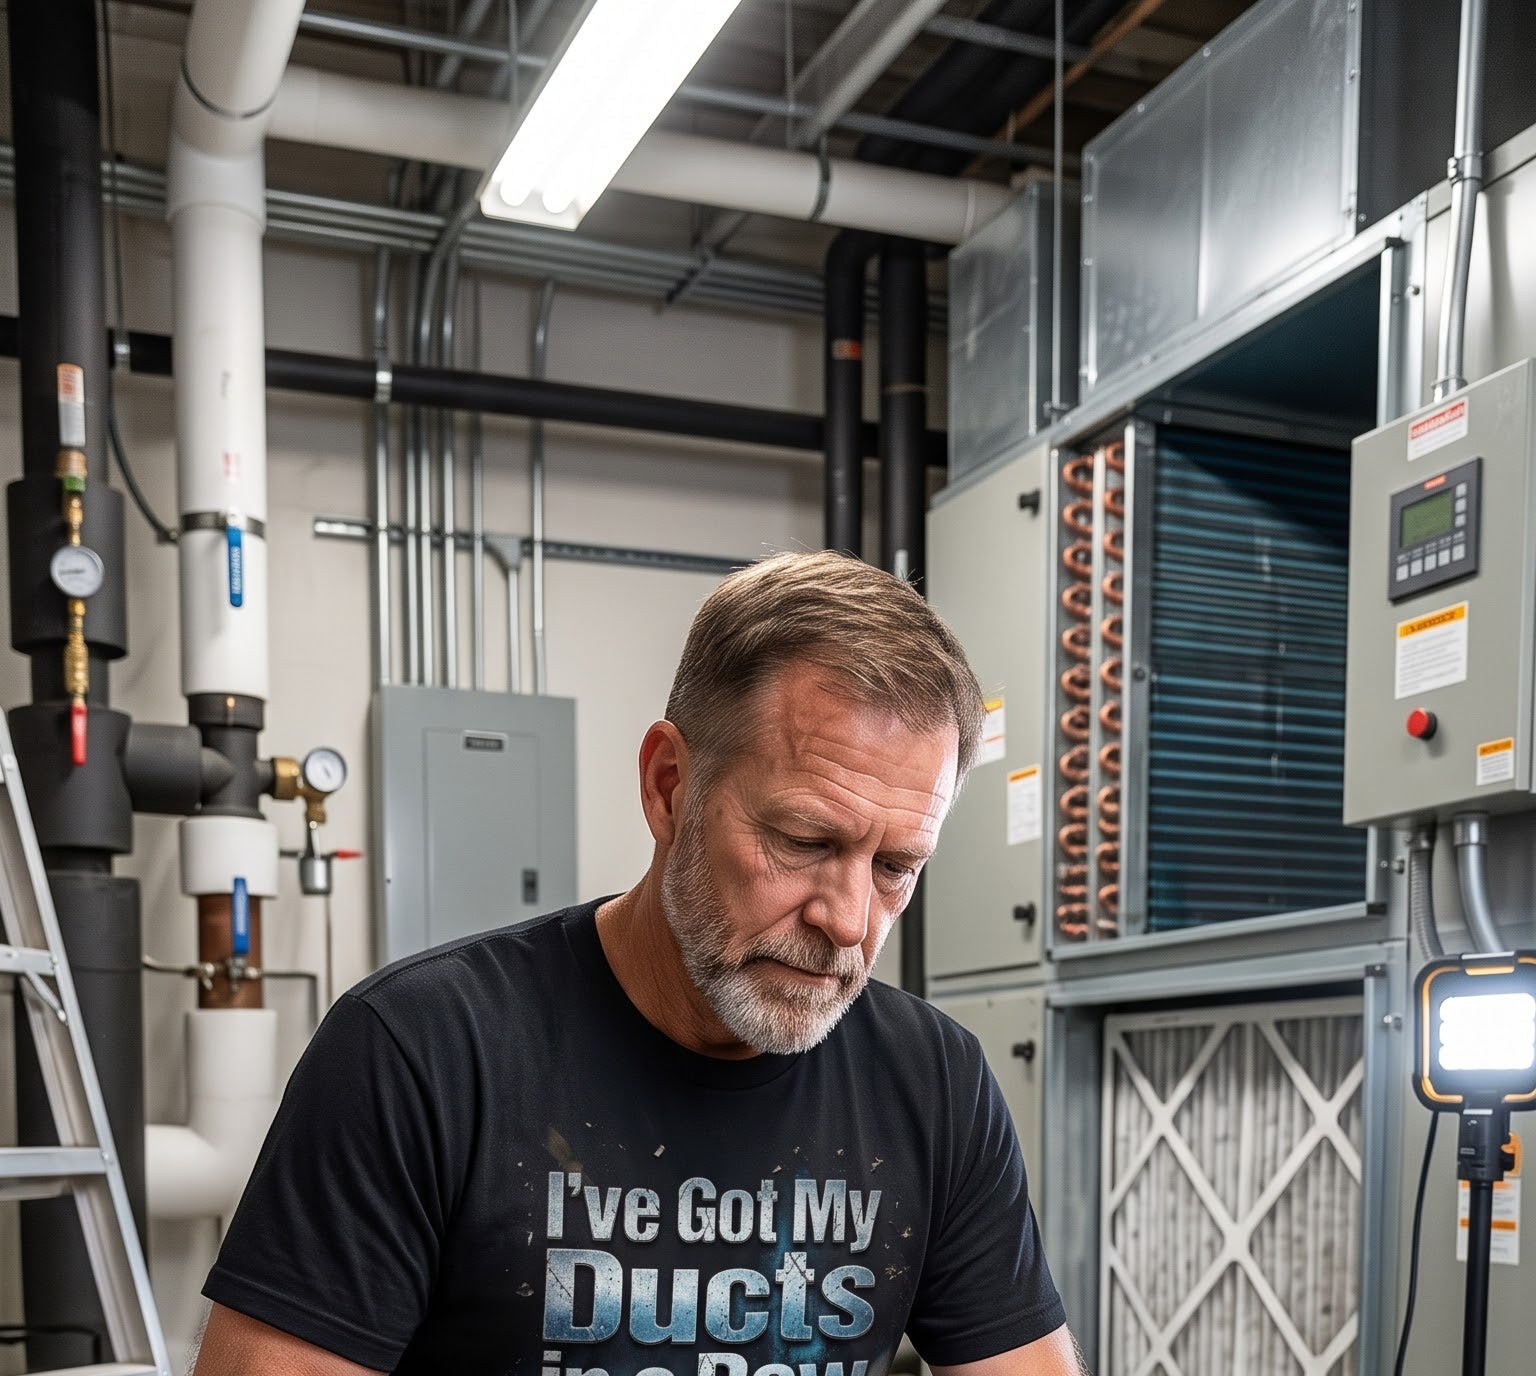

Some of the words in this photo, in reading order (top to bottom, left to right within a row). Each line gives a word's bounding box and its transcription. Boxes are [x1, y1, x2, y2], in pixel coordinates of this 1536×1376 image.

[546, 1170, 660, 1244] I've
[677, 1176, 778, 1244] Got
[792, 1178, 882, 1254] My
[542, 1247, 876, 1345] Ducts
